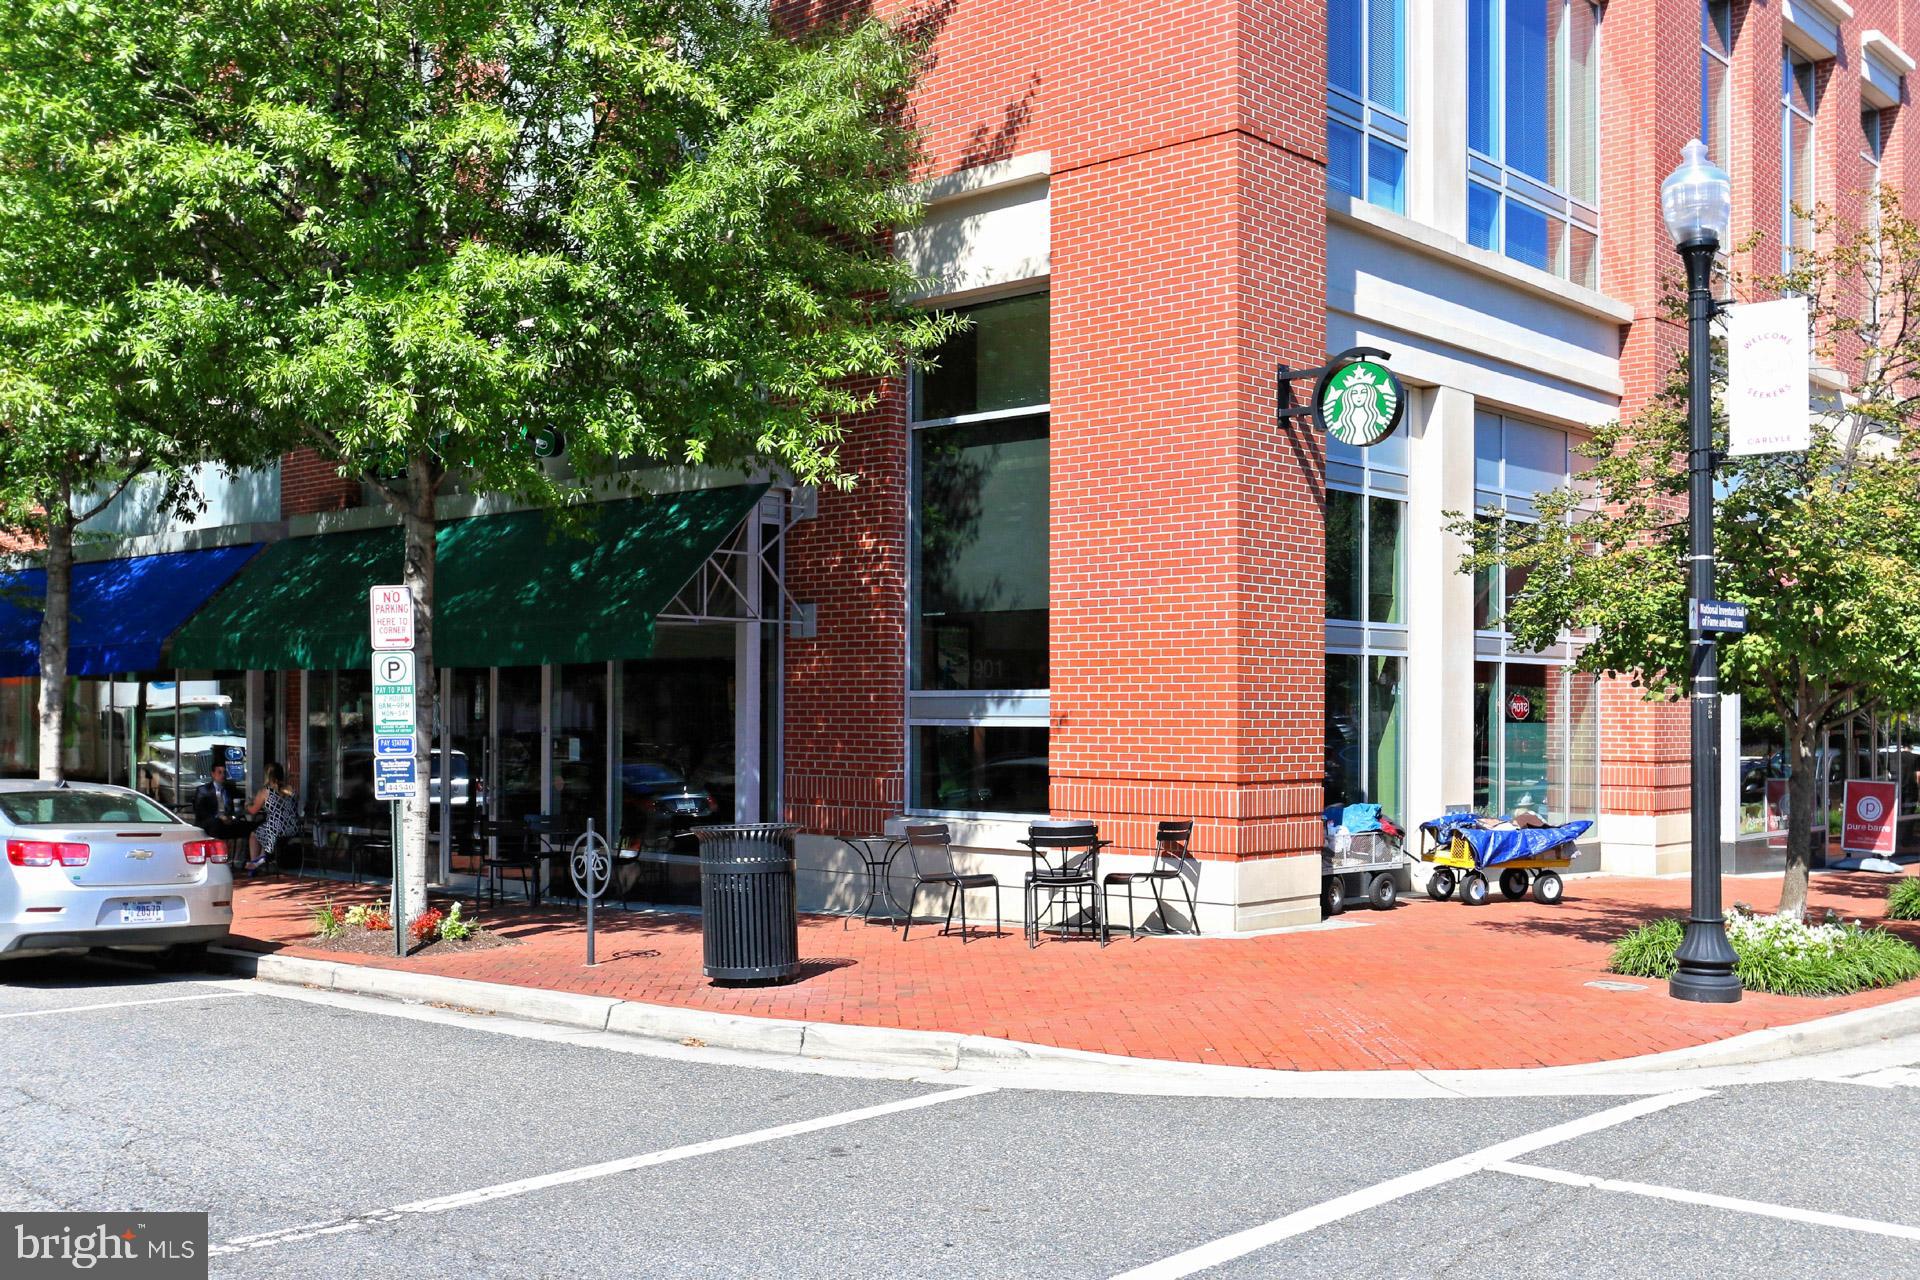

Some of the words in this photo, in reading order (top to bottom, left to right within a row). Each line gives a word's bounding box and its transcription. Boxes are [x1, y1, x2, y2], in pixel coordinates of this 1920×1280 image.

[1743, 332, 1793, 350] WELCOME
[1747, 384, 1792, 398] SEEKERS
[1747, 435, 1792, 446] CARLYLE
[383, 591, 401, 603] NO
[375, 604, 409, 614] PARKING
[377, 617, 396, 626] HERE
[399, 617, 408, 626] TO
[379, 626, 406, 635] CORNER
[388, 661, 400, 679] P
[375, 686, 387, 694] PAY
[388, 686, 395, 694] TO
[396, 686, 411, 694] PARK
[388, 695, 405, 703] HOUR
[1846, 823, 1867, 831] pure
[1867, 824, 1891, 833] barre
